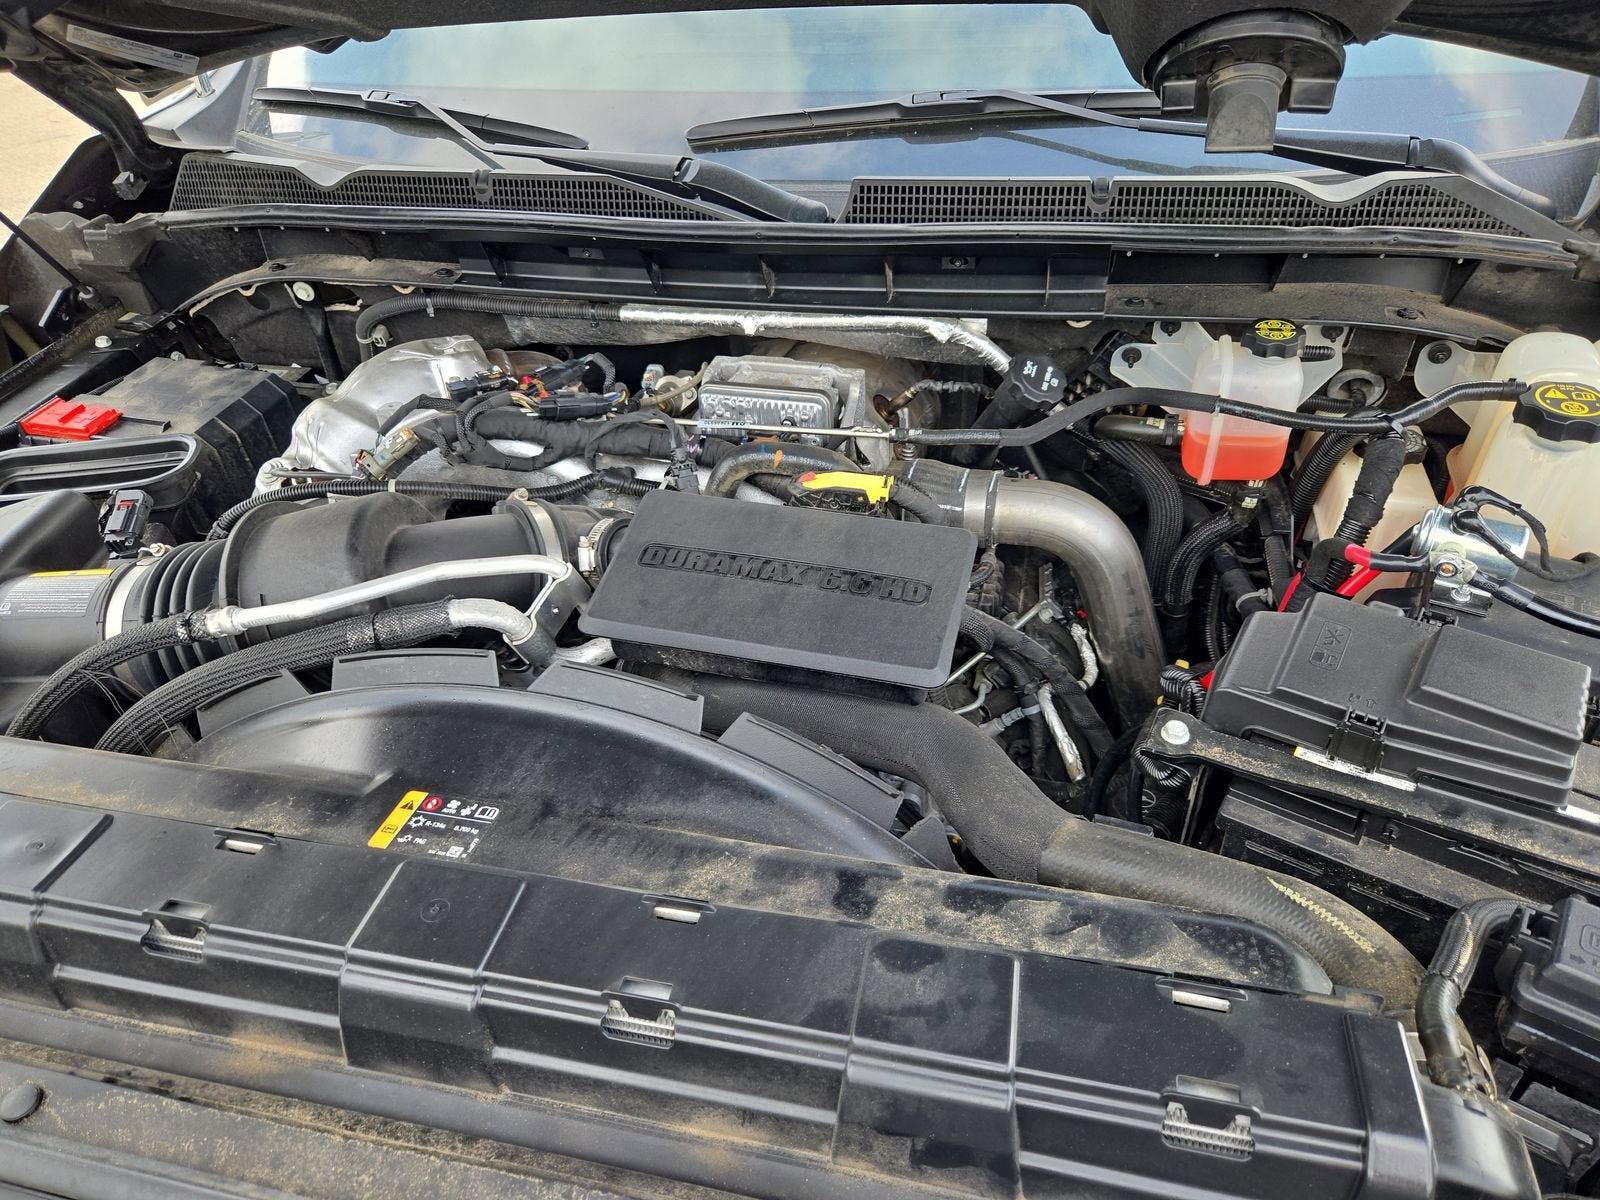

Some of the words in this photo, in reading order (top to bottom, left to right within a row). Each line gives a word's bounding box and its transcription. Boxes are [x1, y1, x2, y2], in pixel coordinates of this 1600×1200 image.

[641, 546, 809, 585] DURAMAX
[819, 567, 873, 594] 6.6
[879, 577, 931, 603] HD
[425, 821, 447, 829] R-134a
[453, 825, 471, 833] 0.700
[471, 827, 480, 835] kg
